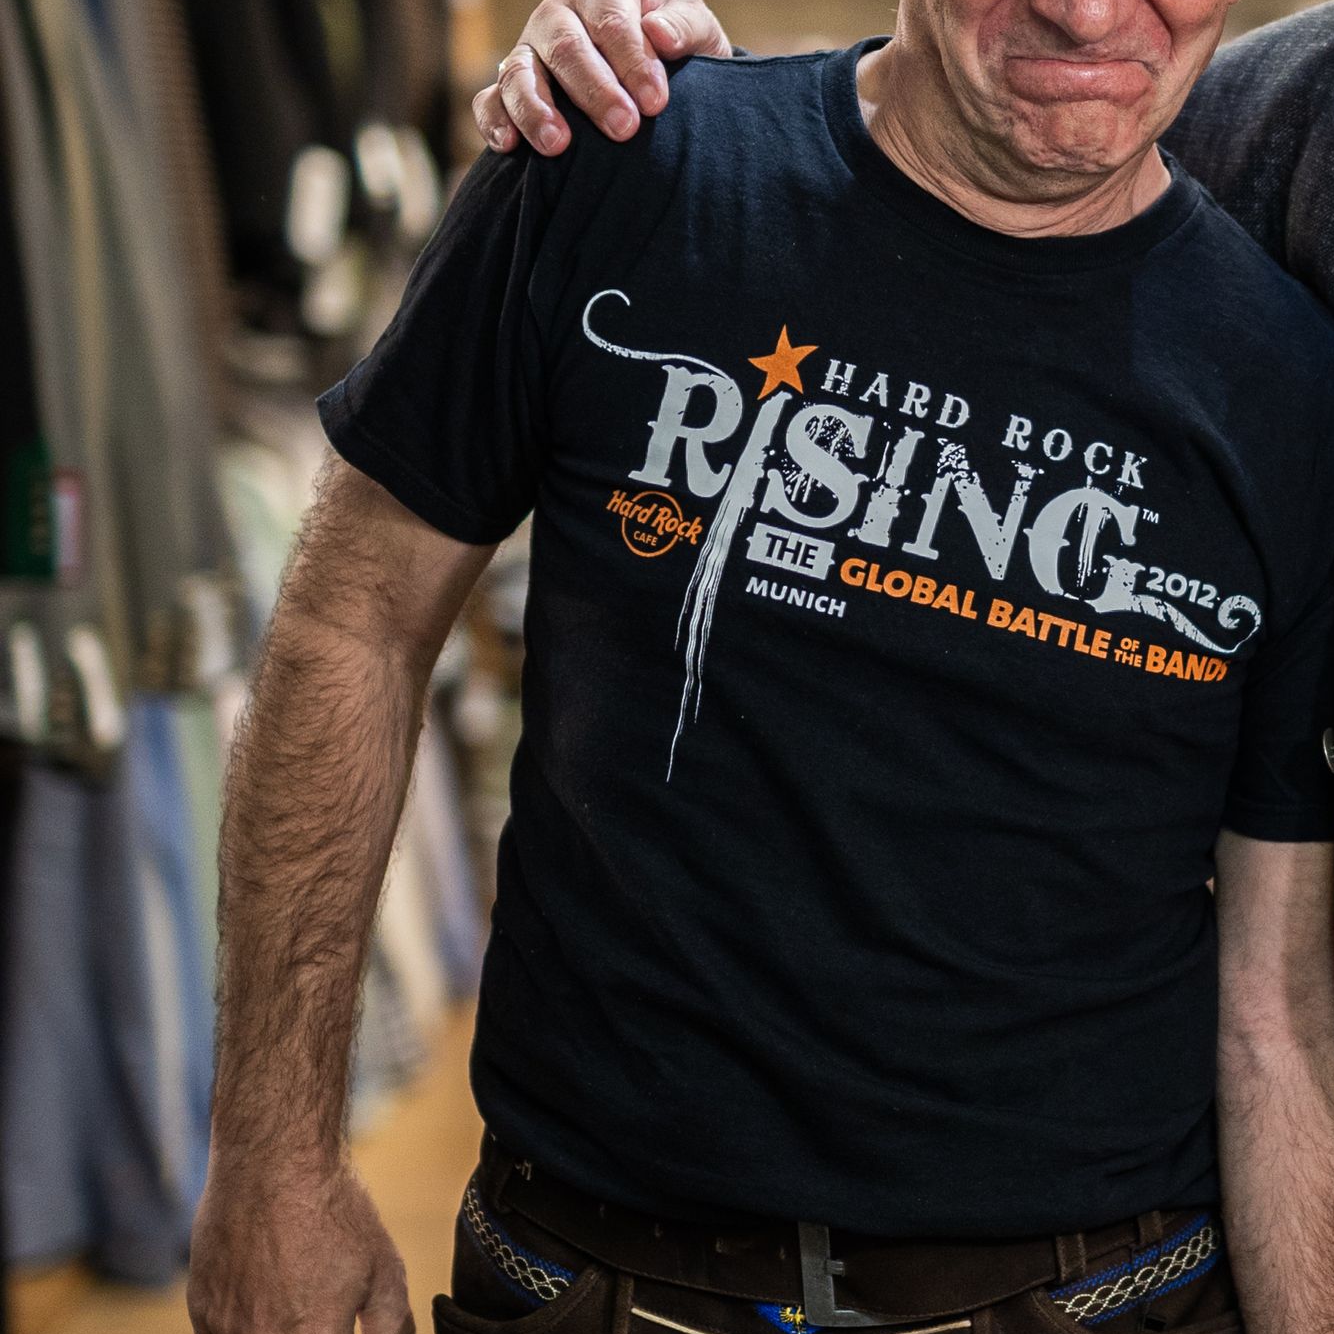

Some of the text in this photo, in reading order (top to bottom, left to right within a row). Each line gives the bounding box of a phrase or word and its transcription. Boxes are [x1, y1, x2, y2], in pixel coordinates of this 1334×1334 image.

[820, 359, 1148, 489] HARD ROCK
[628, 364, 1144, 614] RISING
[605, 489, 704, 546] Hard Rock
[633, 530, 659, 548] CAFE
[765, 531, 820, 571] THE
[745, 576, 847, 618] MUNICH
[840, 557, 1112, 659] GLOBAL BATTLE
[1146, 567, 1218, 609] 2012
[1114, 648, 1143, 668] THE
[1120, 637, 1140, 652] OF
